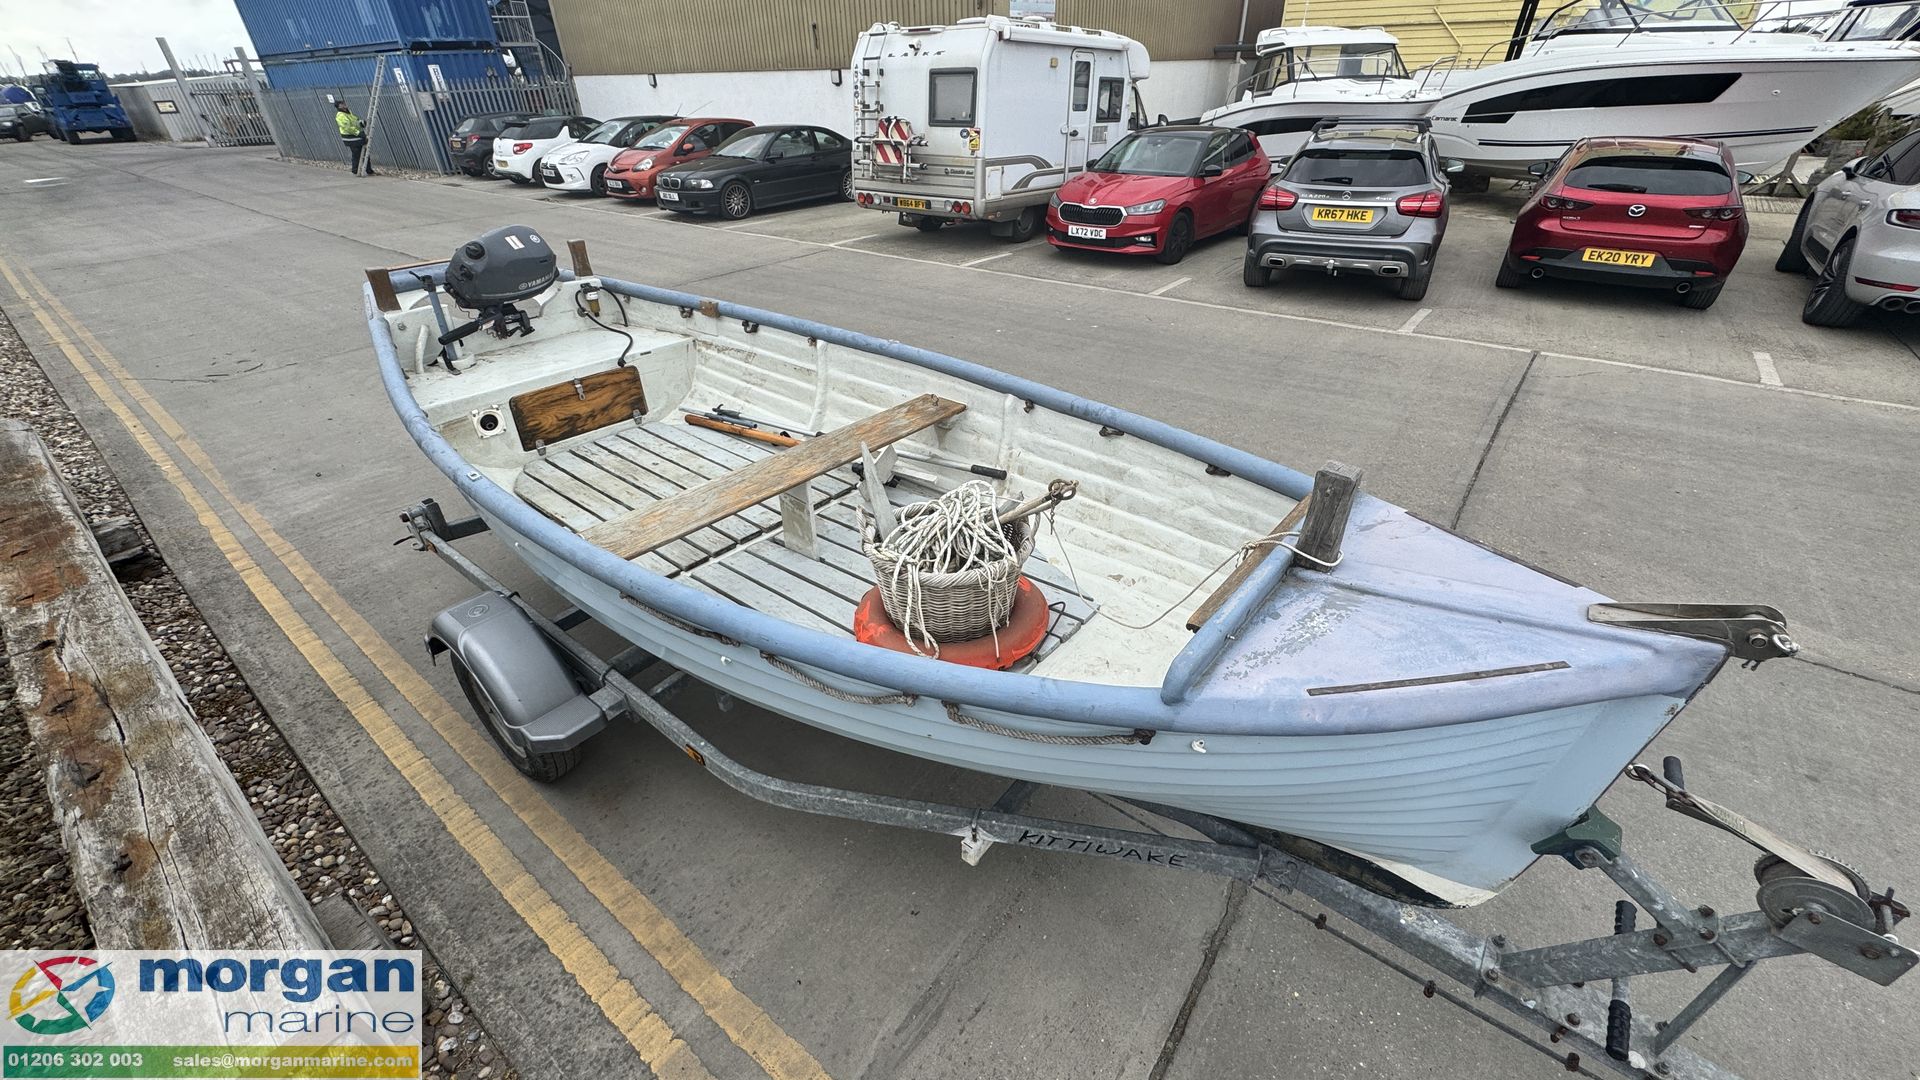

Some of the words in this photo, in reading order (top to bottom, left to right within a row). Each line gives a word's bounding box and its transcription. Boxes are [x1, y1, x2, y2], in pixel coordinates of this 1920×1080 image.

[1317, 209, 1345, 219] KR67
[1346, 210, 1368, 221] HKE
[1071, 227, 1089, 236] LX72
[1090, 229, 1104, 238] VDC
[1588, 250, 1621, 262] EK20
[1622, 253, 1649, 264] YRY
[1018, 830, 1187, 867] KITTIWAKE
